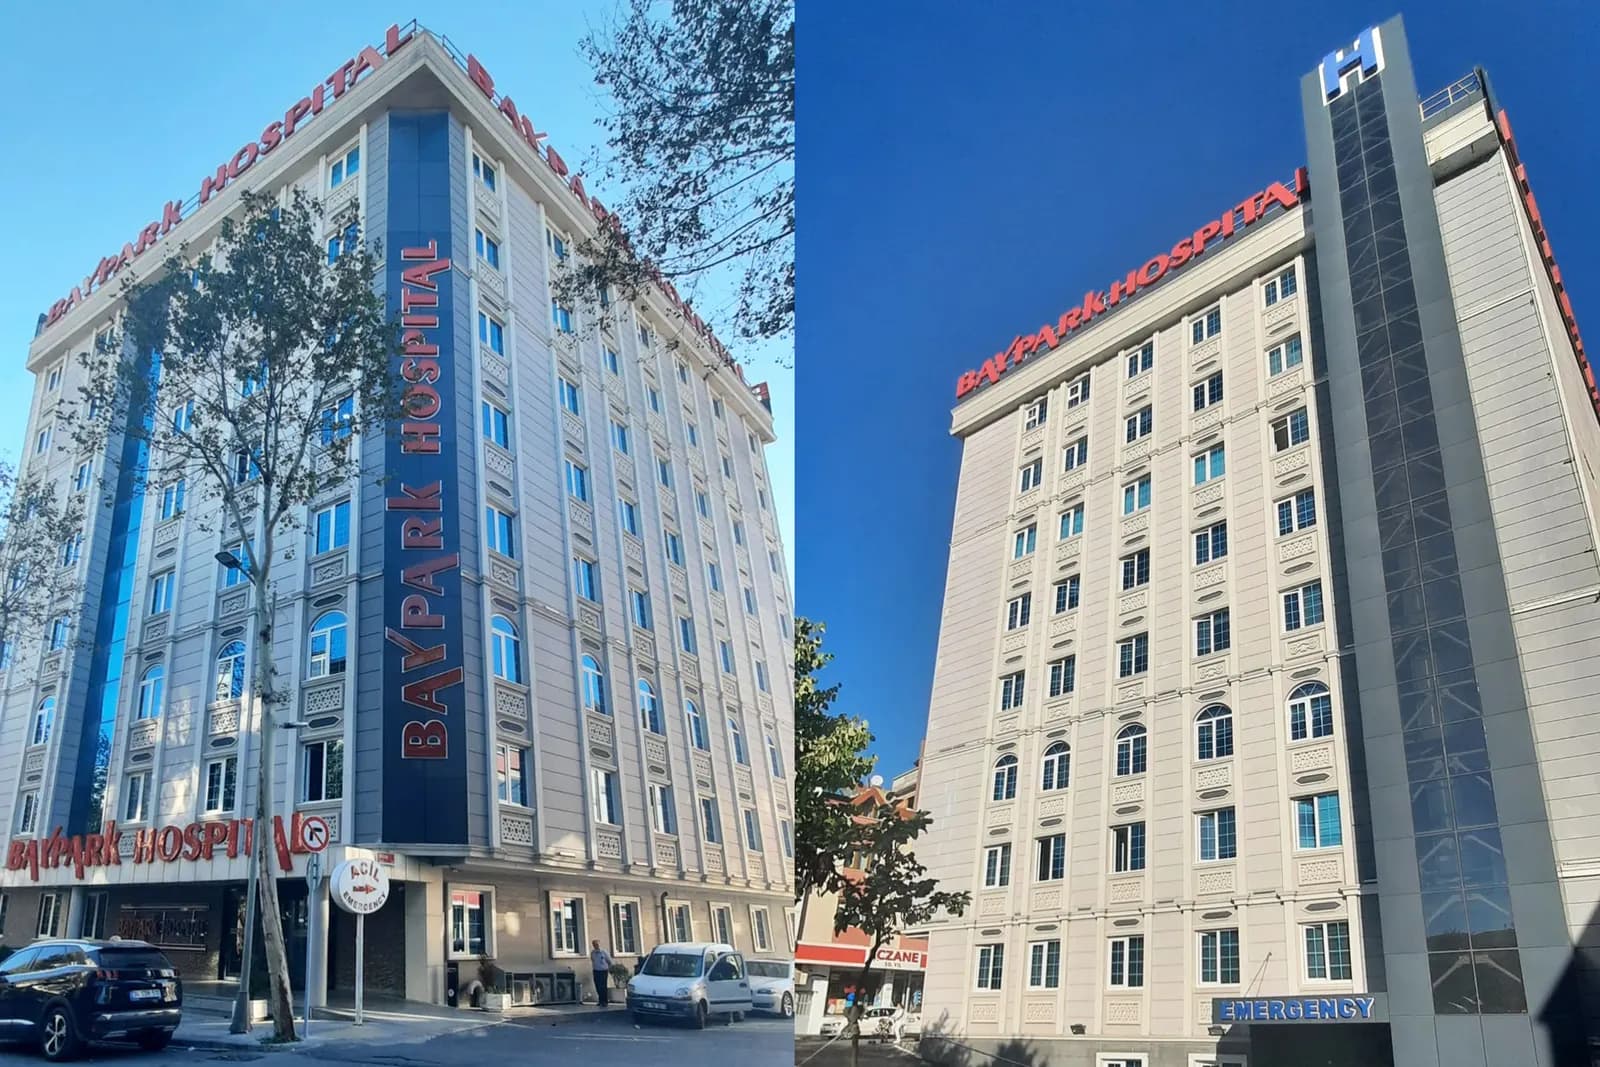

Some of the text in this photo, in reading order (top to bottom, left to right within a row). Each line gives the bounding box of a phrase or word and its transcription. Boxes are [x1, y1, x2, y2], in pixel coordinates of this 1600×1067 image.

[1319, 26, 1385, 107] H
[46, 23, 413, 328] BAYPARK HOSPITAL
[956, 289, 1106, 399] BAYPARK
[385, 239, 464, 760] BAYPARK HOSPITAL
[7, 820, 123, 881] BAYPARK
[343, 890, 386, 912] EMERGENCY
[876, 949, 919, 963] CZANE
[1219, 998, 1375, 1021] EMERGENCY
